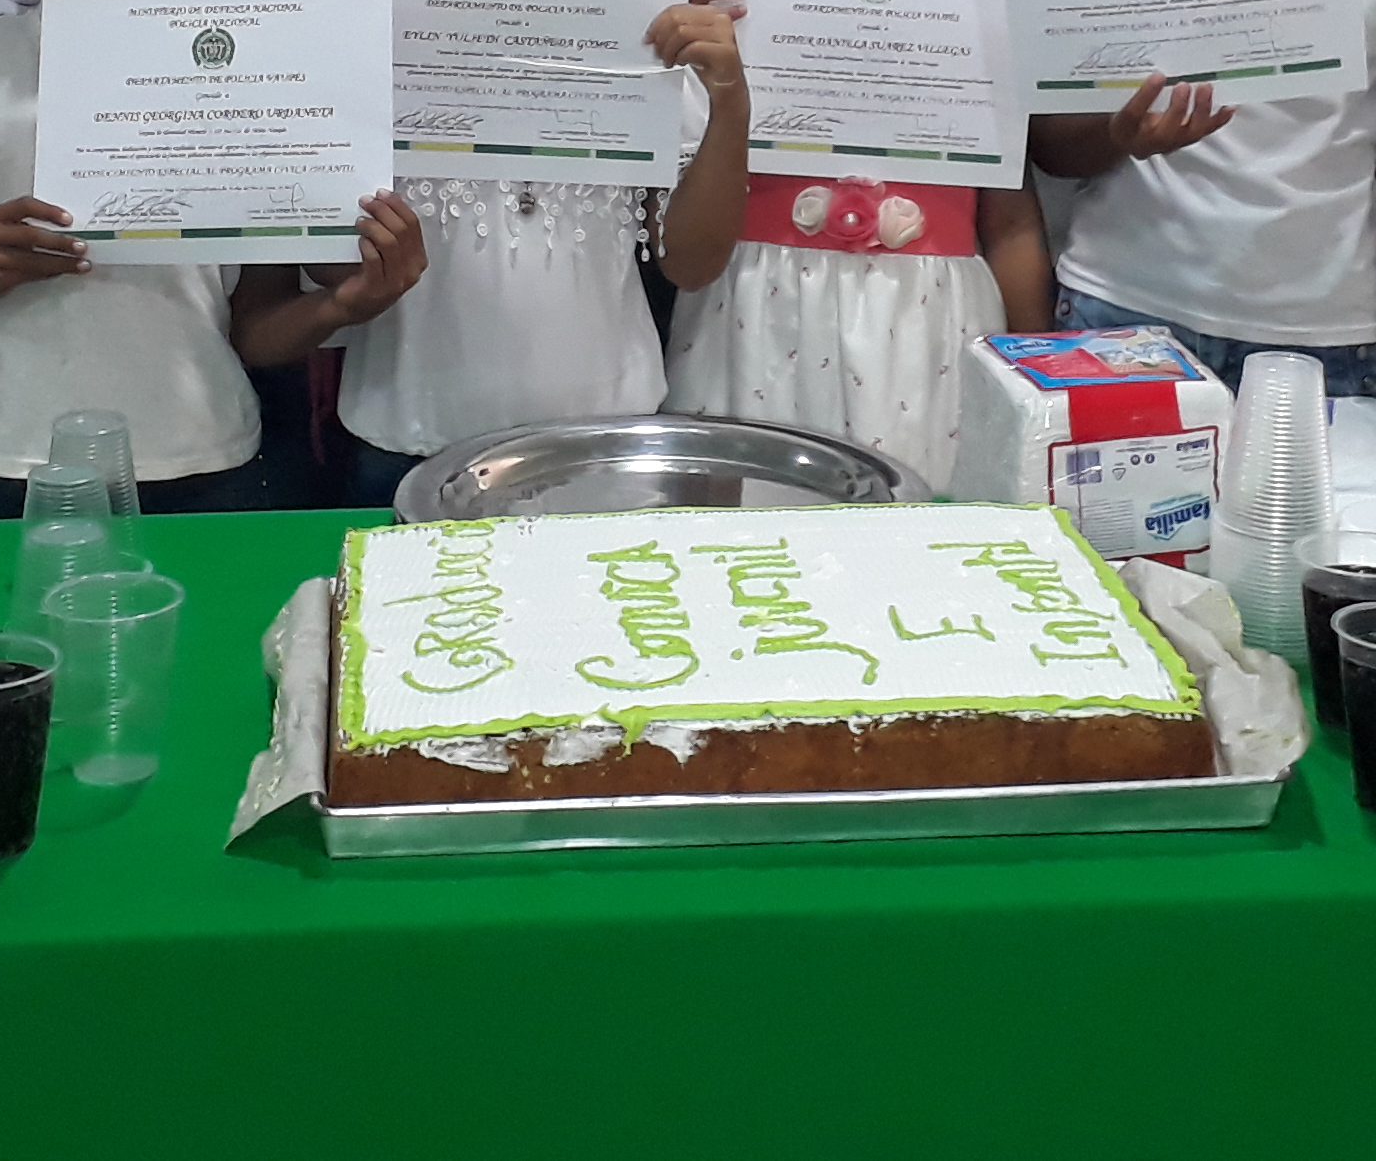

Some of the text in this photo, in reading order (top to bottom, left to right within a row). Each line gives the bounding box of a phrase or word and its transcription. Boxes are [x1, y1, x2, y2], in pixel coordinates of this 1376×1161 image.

[93, 111, 140, 123] DENNIS
[206, 109, 264, 121] CORDERO
[1145, 499, 1212, 533] familia
[888, 604, 996, 643] E
